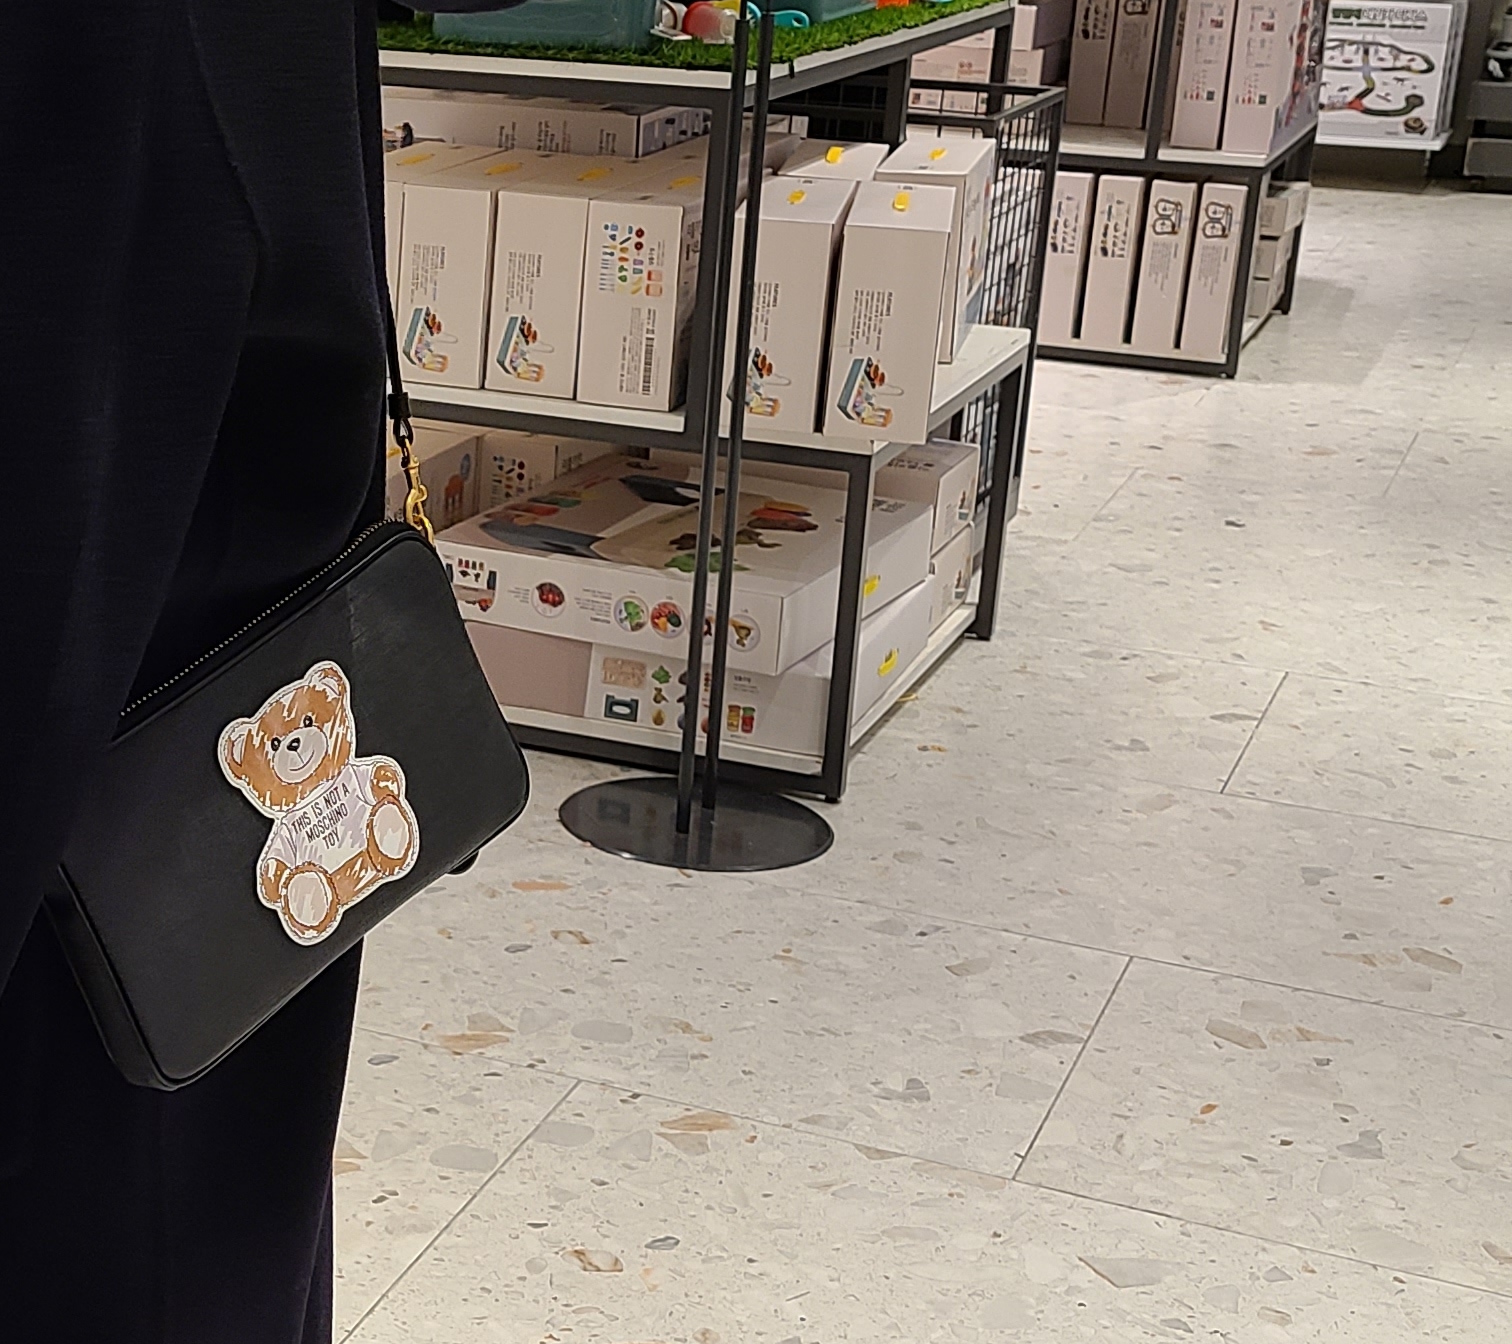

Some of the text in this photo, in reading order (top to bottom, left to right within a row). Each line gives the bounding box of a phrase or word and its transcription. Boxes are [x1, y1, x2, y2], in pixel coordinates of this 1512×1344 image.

[291, 782, 350, 834] THIS IS NOT A
[305, 802, 349, 843] MOSCHINO
[322, 827, 340, 849] TOY
